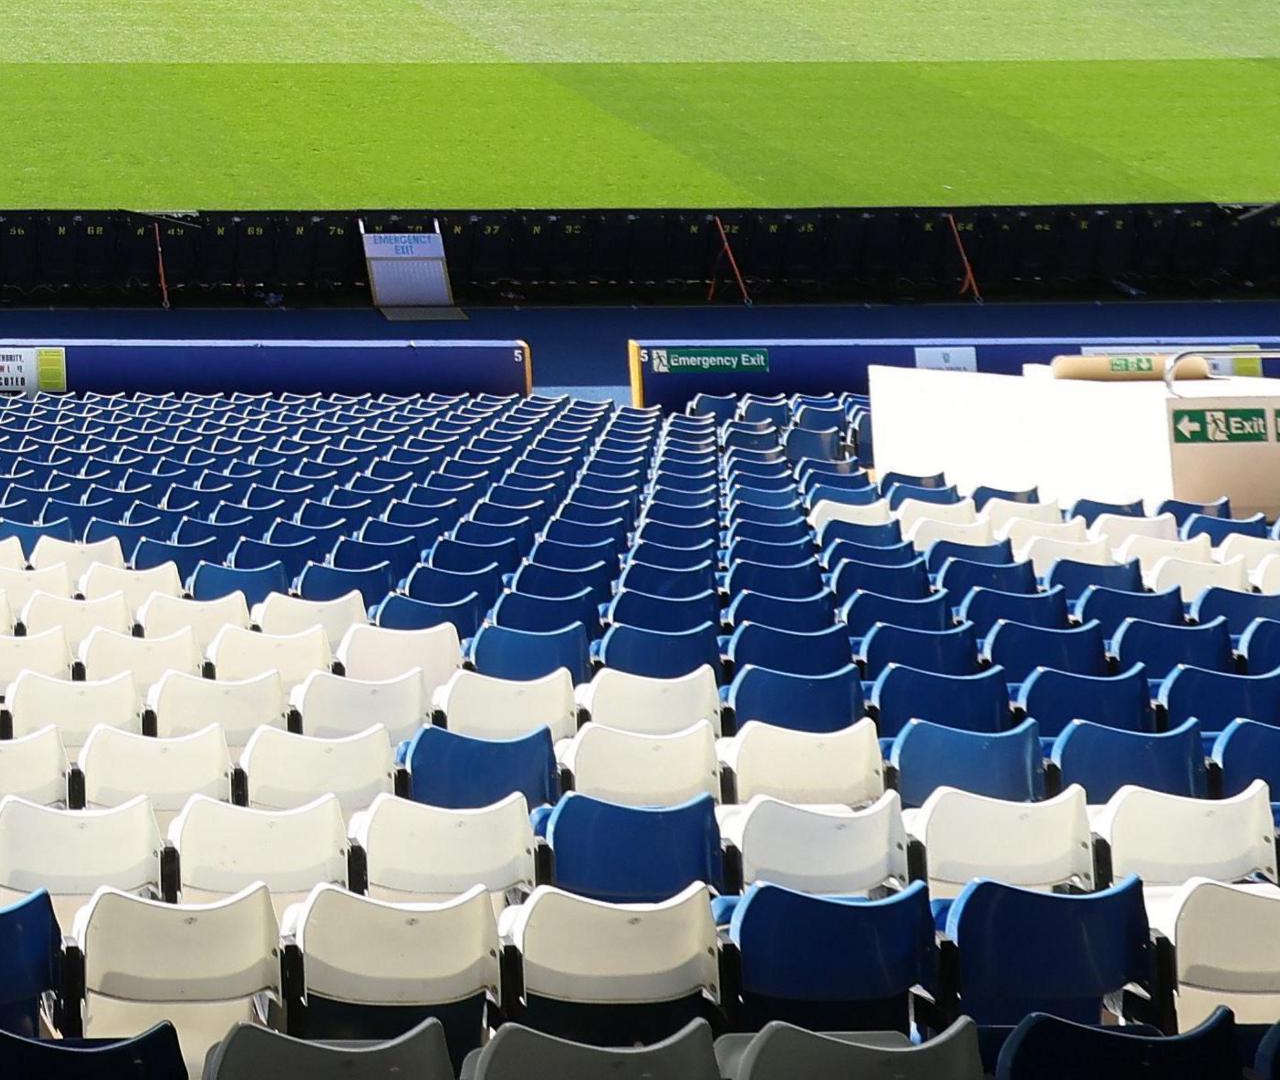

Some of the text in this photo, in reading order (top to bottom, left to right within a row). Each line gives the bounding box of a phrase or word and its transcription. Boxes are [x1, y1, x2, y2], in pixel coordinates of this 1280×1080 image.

[373, 235, 431, 245] EMERGENCY
[394, 245, 414, 255] EXIT
[513, 350, 523, 362] 5
[639, 350, 649, 362] 5
[670, 353, 766, 369] Emergency Exit
[1228, 416, 1265, 435] Exit
